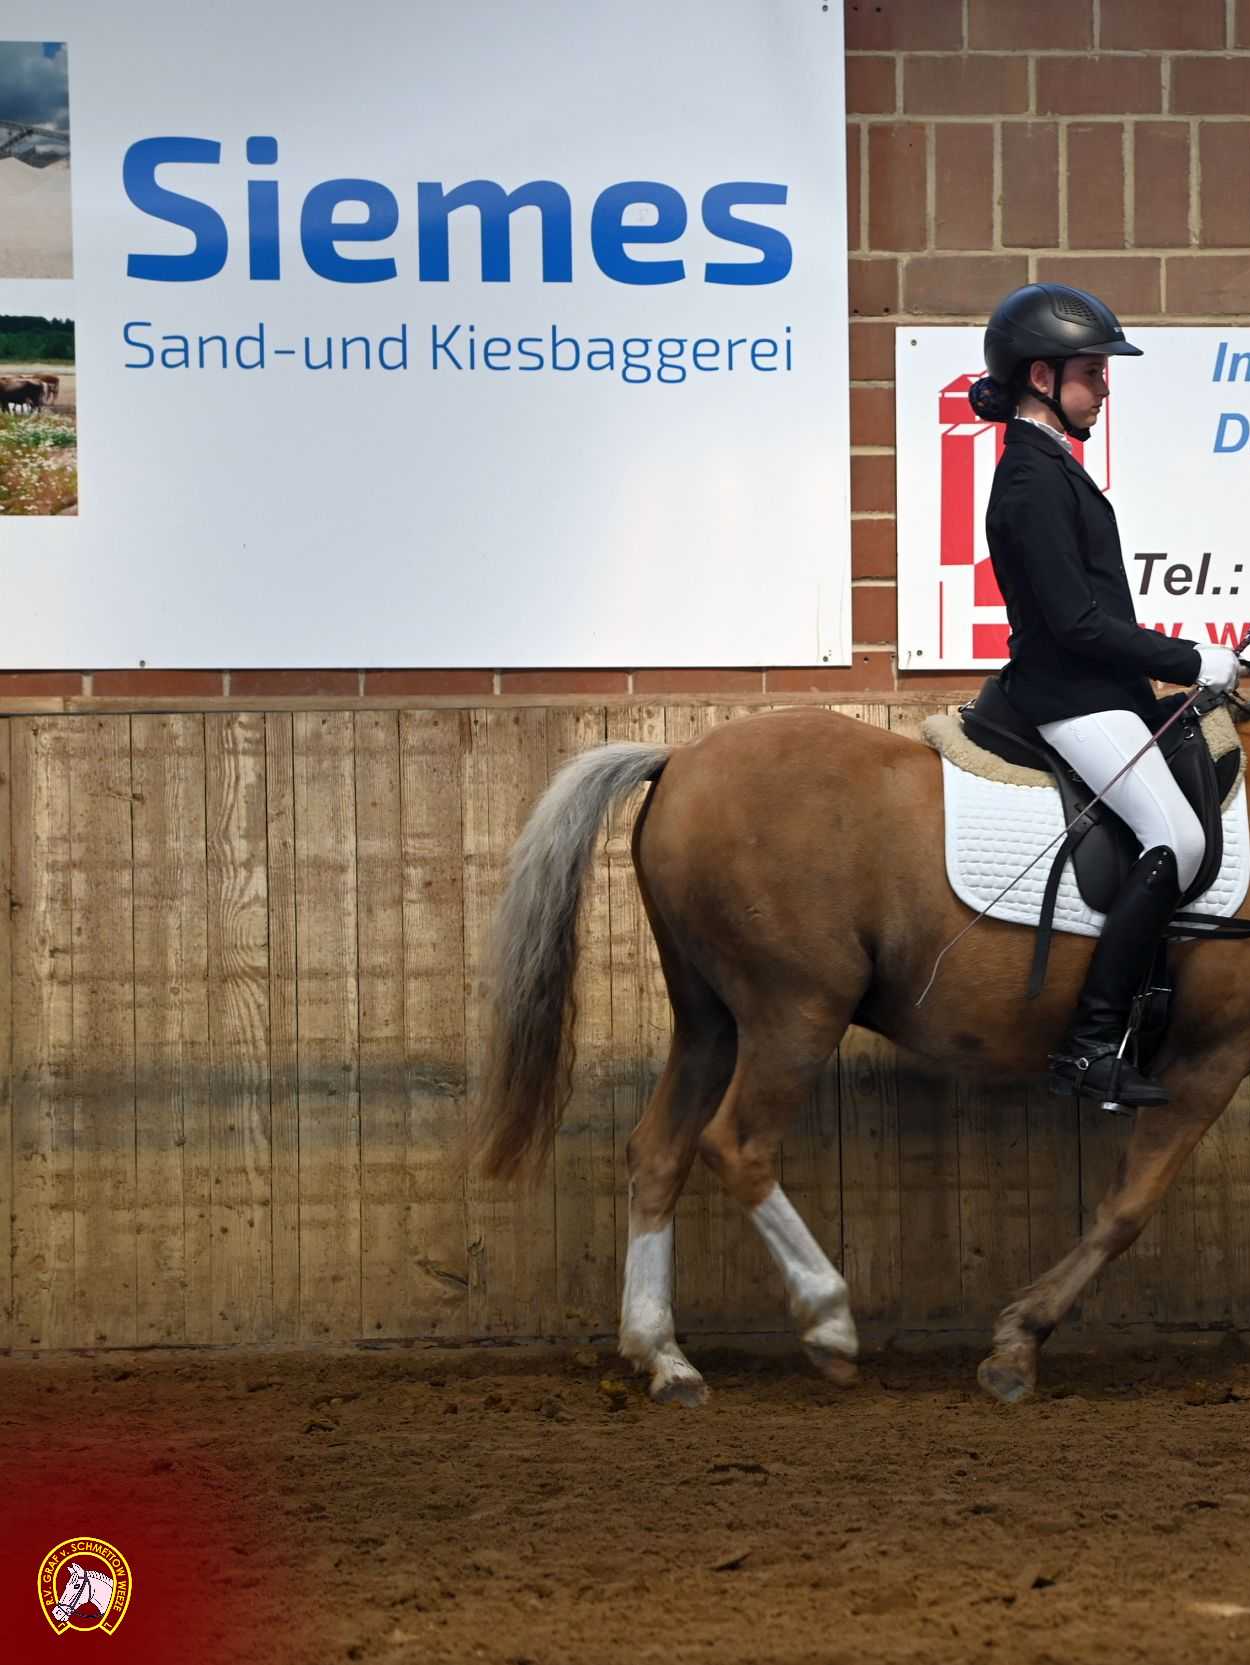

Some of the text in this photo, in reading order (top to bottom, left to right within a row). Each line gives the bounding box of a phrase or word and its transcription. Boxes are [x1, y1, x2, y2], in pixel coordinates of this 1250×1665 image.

[121, 135, 795, 287] Siemes
[122, 320, 793, 385] Sand-und Kiesbaggerei
[1134, 552, 1243, 596] Tel.:
